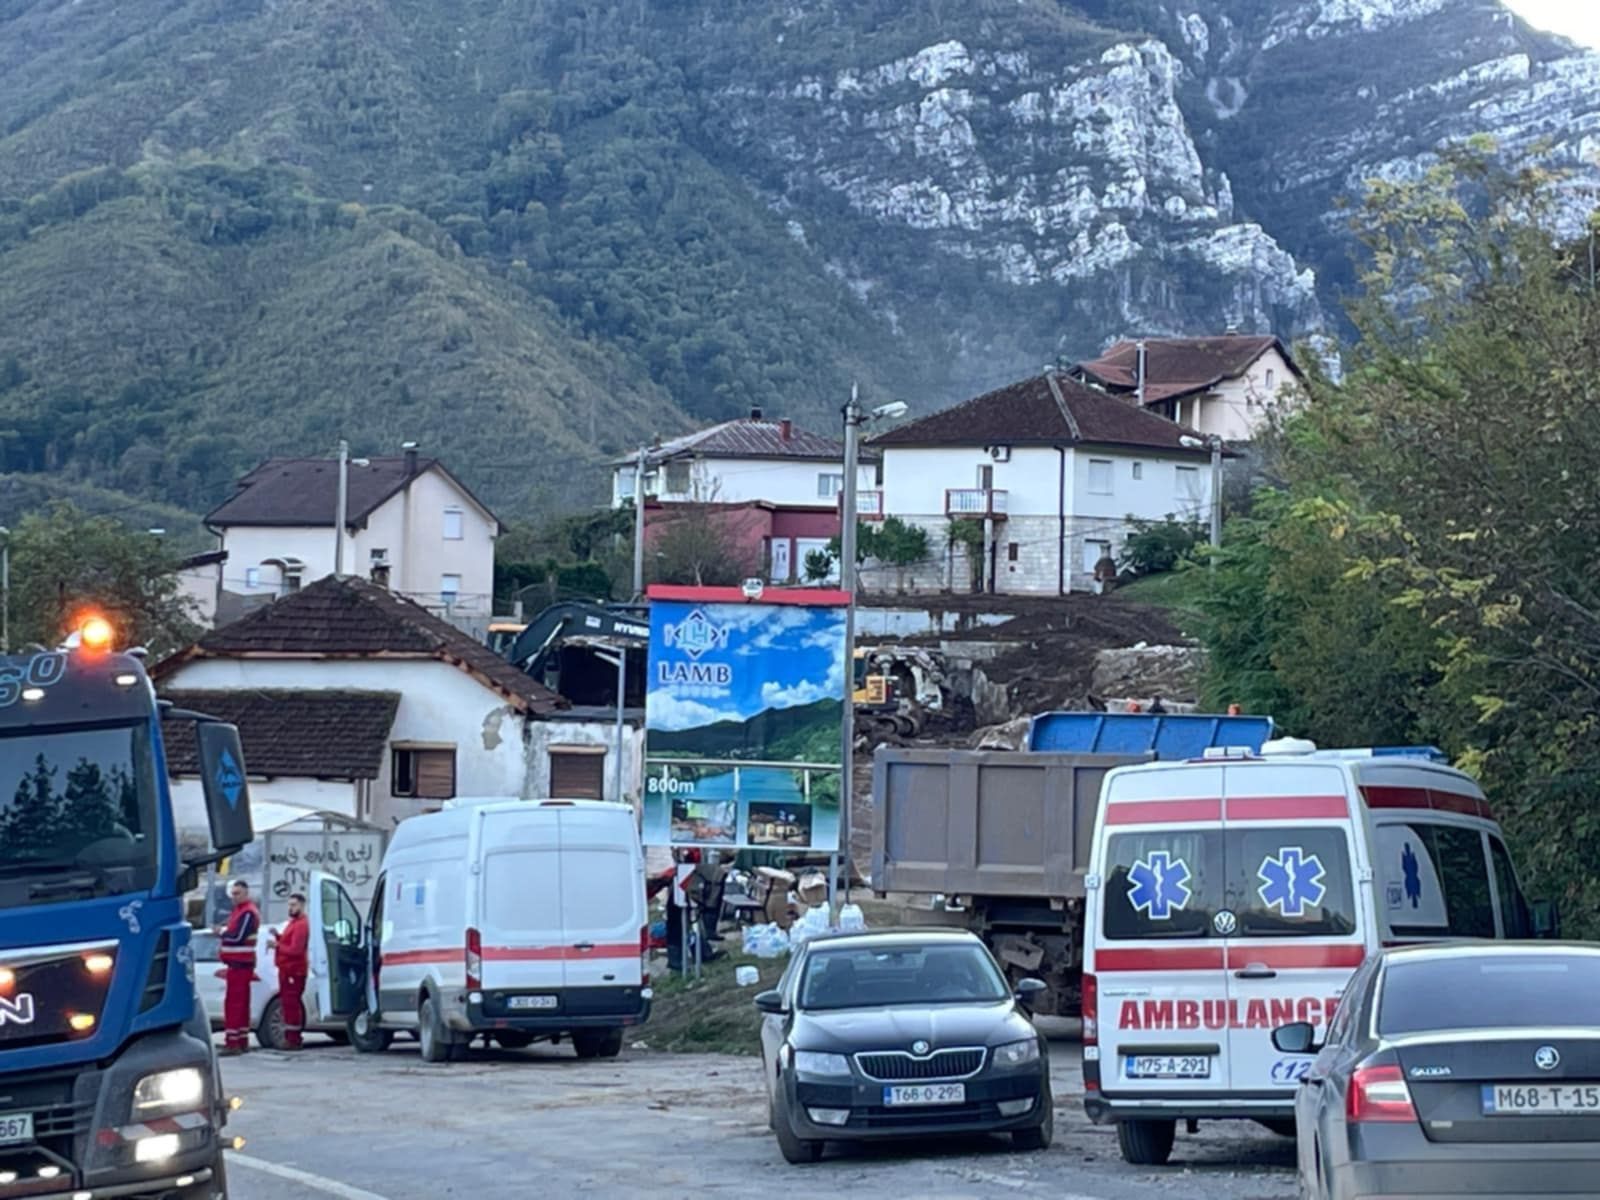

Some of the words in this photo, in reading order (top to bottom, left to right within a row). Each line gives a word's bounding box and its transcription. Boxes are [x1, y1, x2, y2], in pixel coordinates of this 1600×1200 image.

[660, 662, 731, 683] LAMB
[648, 777, 695, 793] 800m
[1136, 1058, 1206, 1073] M75-A-291
